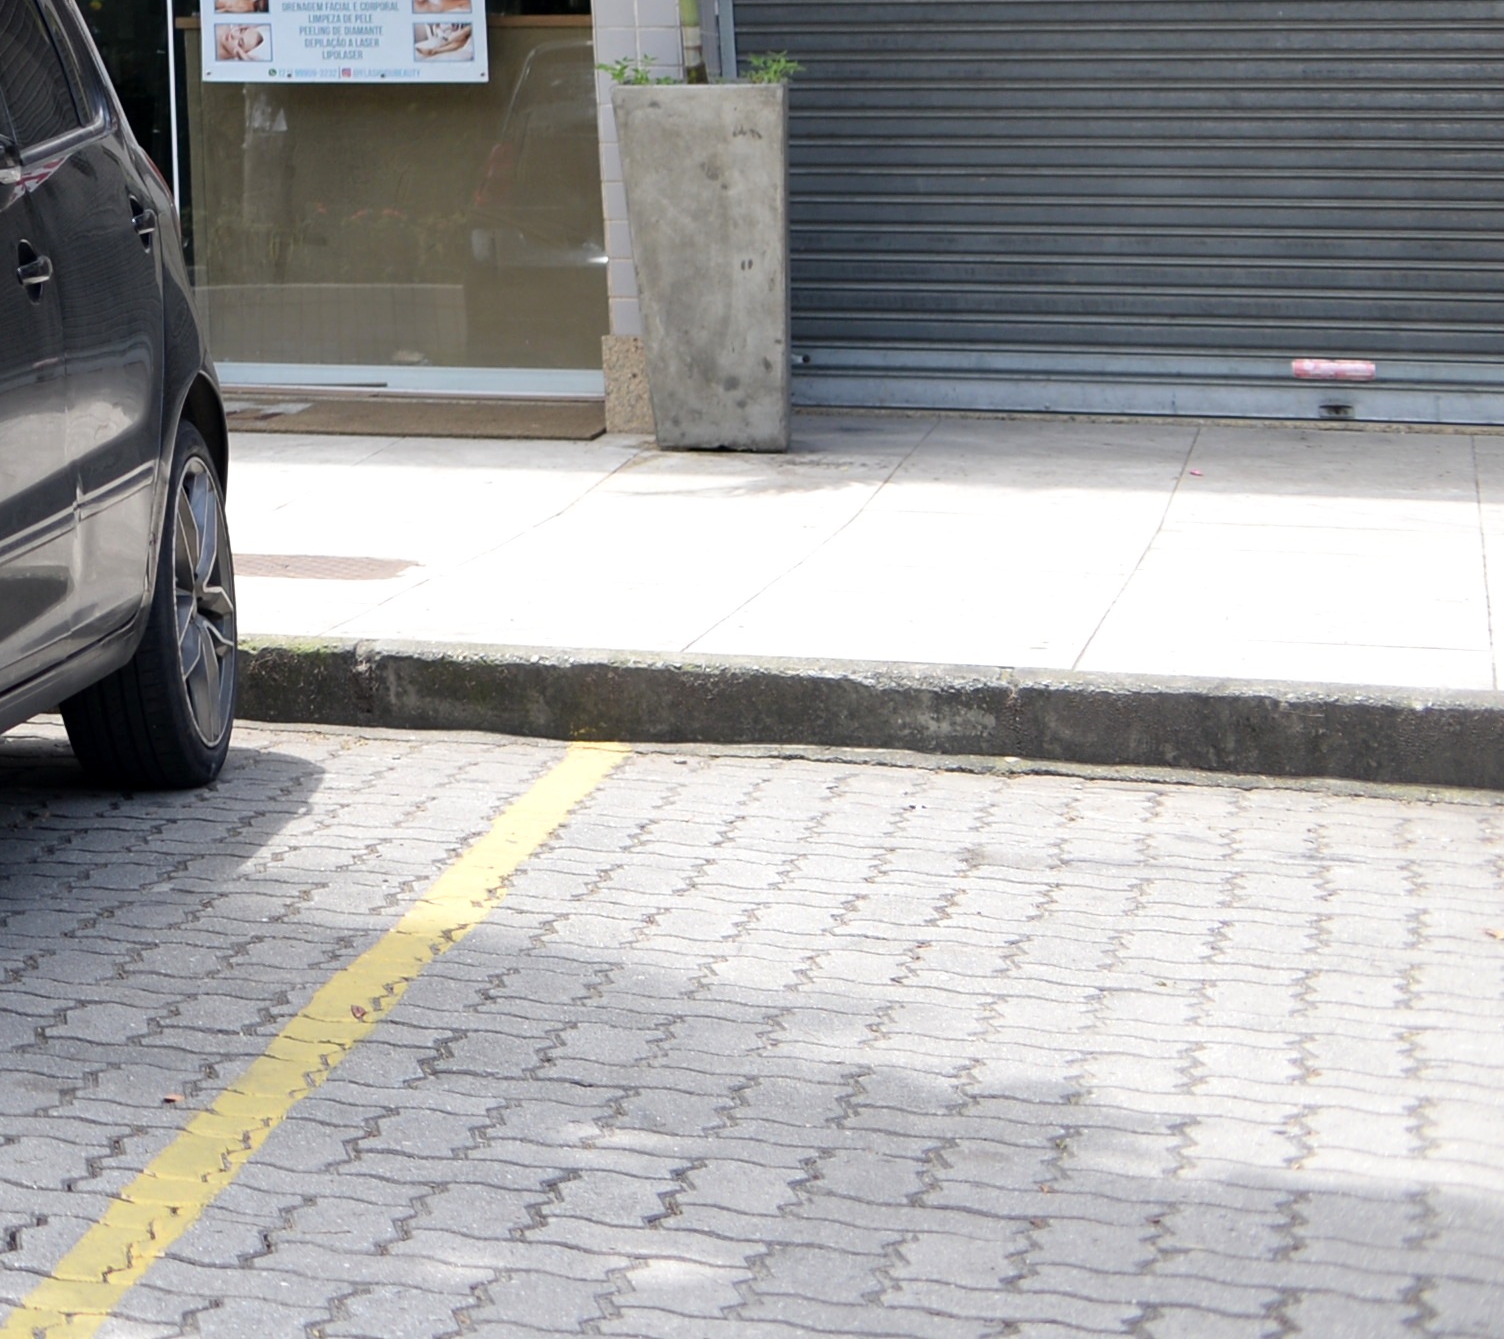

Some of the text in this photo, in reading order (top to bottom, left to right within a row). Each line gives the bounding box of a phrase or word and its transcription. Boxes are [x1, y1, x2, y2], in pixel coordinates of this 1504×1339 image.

[325, 2, 351, 11] FACIAL
[308, 13, 373, 23] LIMPEZA DE PELE
[299, 25, 383, 35] PEELING DE DIAMANTE
[304, 36, 347, 48] DEPILAÇÃO
[355, 37, 380, 47] LASER
[321, 50, 363, 60] LIPOLASER
